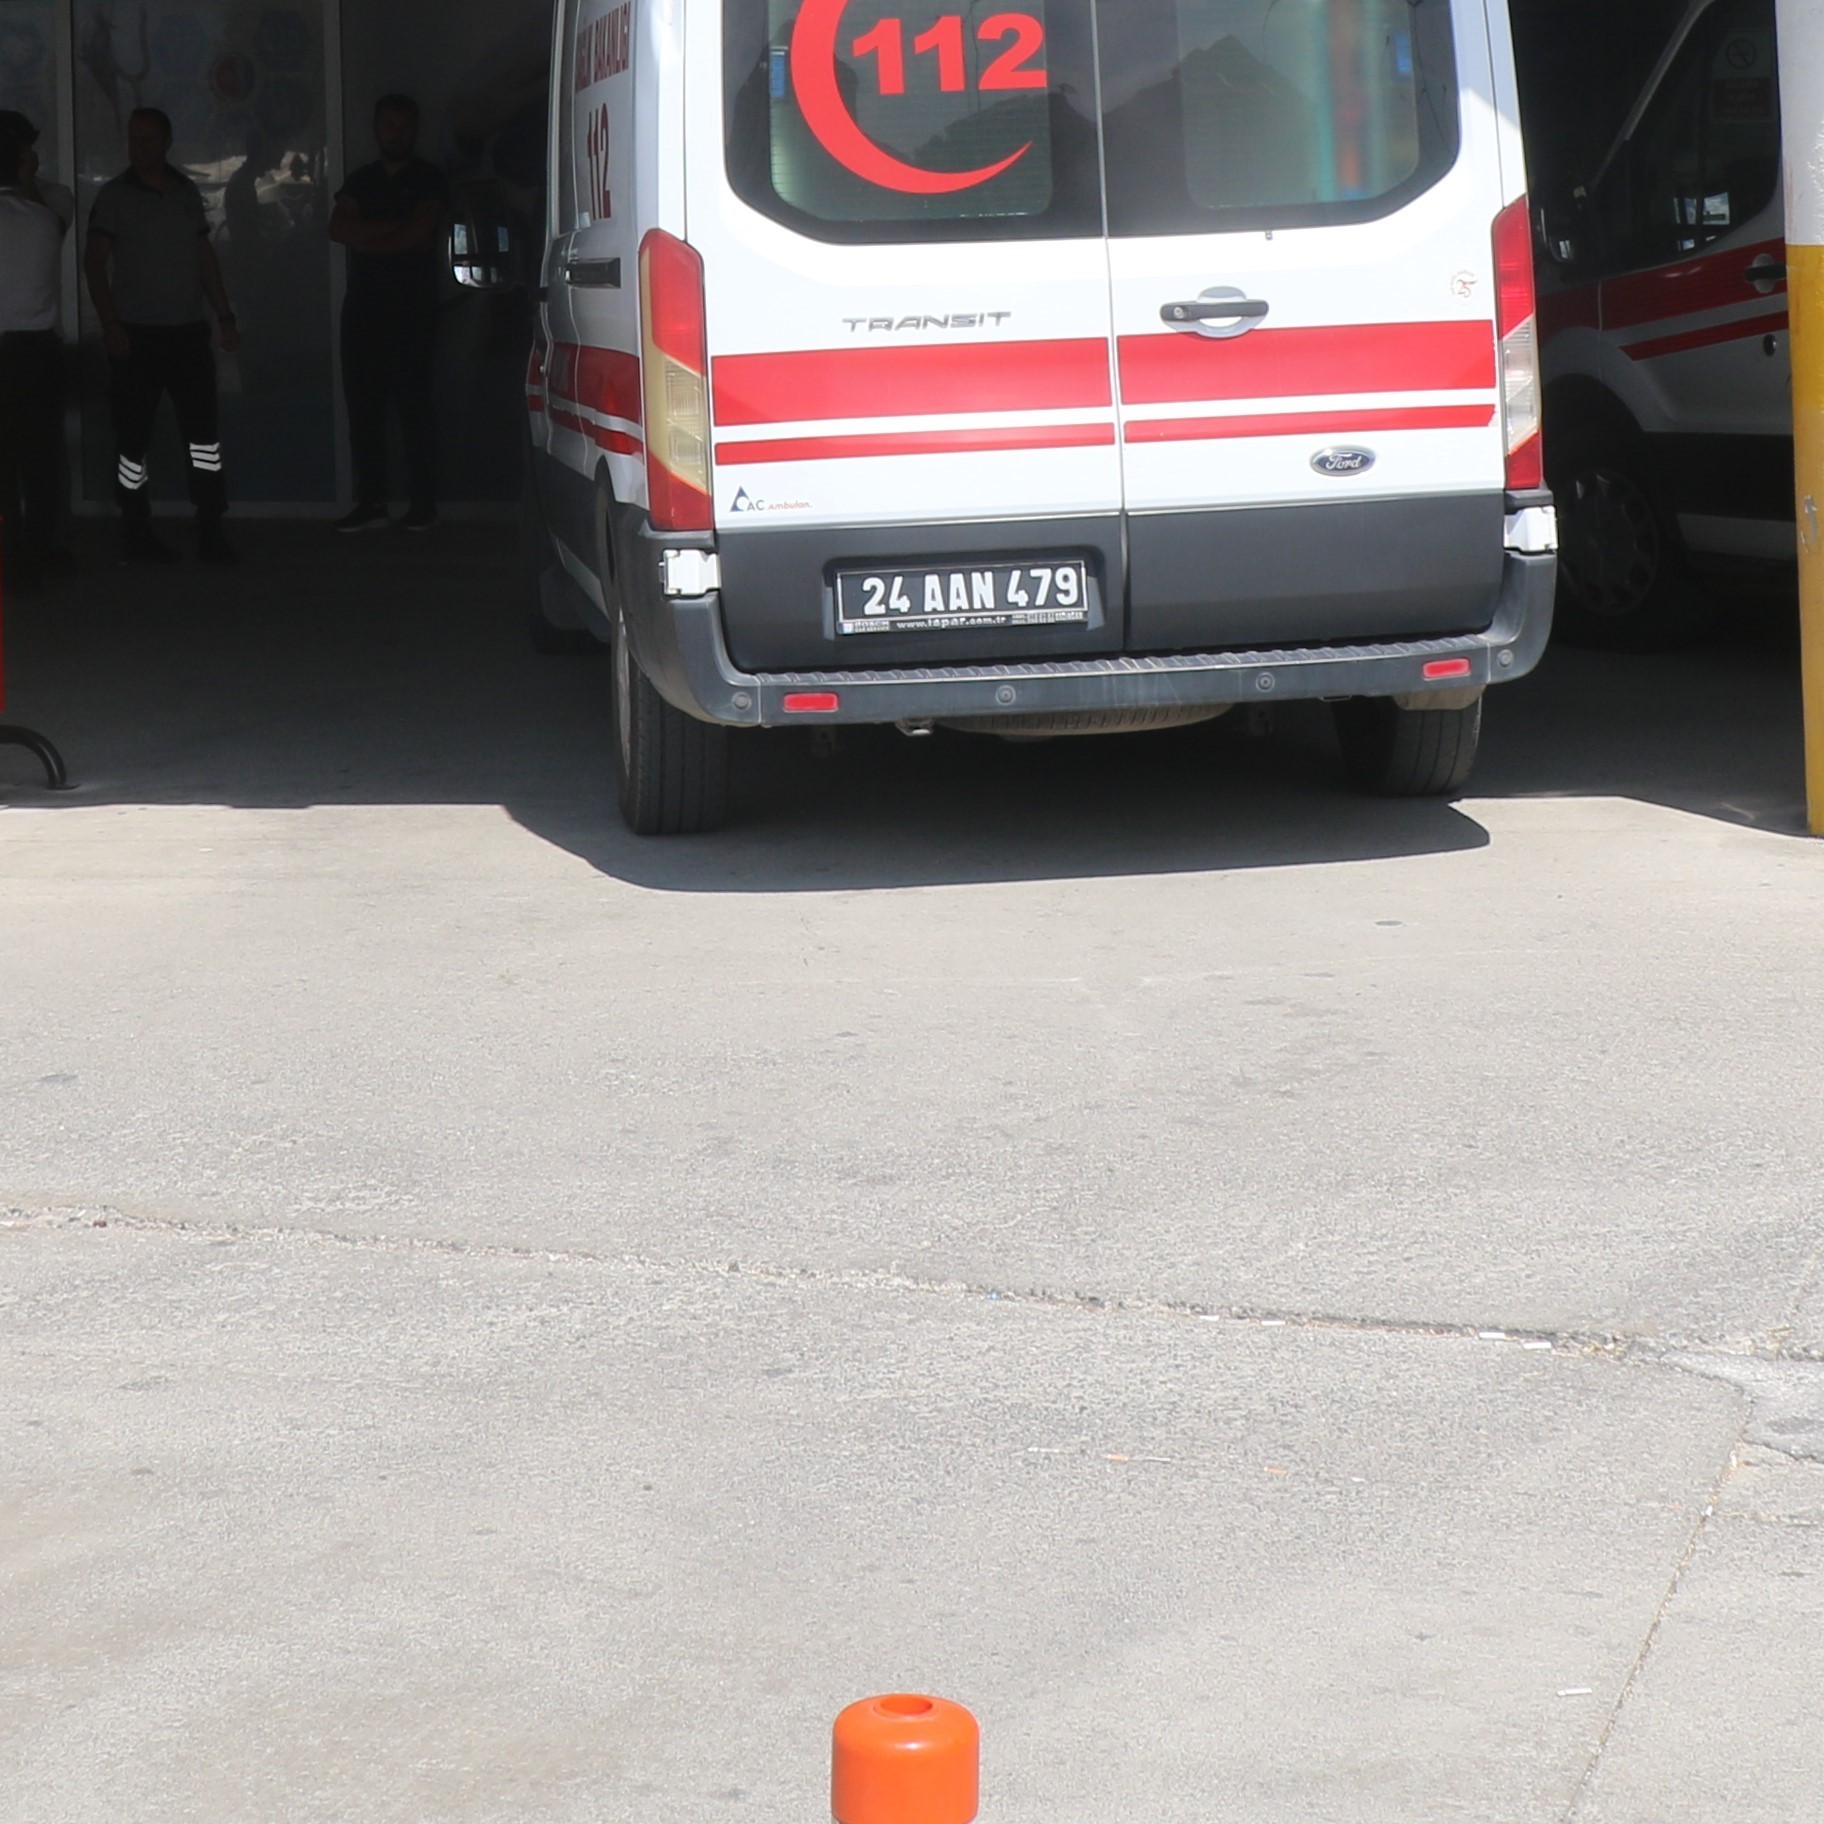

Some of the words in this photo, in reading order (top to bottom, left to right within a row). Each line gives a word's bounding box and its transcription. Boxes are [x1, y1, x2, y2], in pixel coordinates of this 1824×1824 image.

[853, 13, 1047, 95] 112
[842, 311, 1011, 332] TRANSIT
[862, 576, 910, 615] 24
[923, 571, 995, 613] AAN
[1007, 567, 1079, 607] 479
